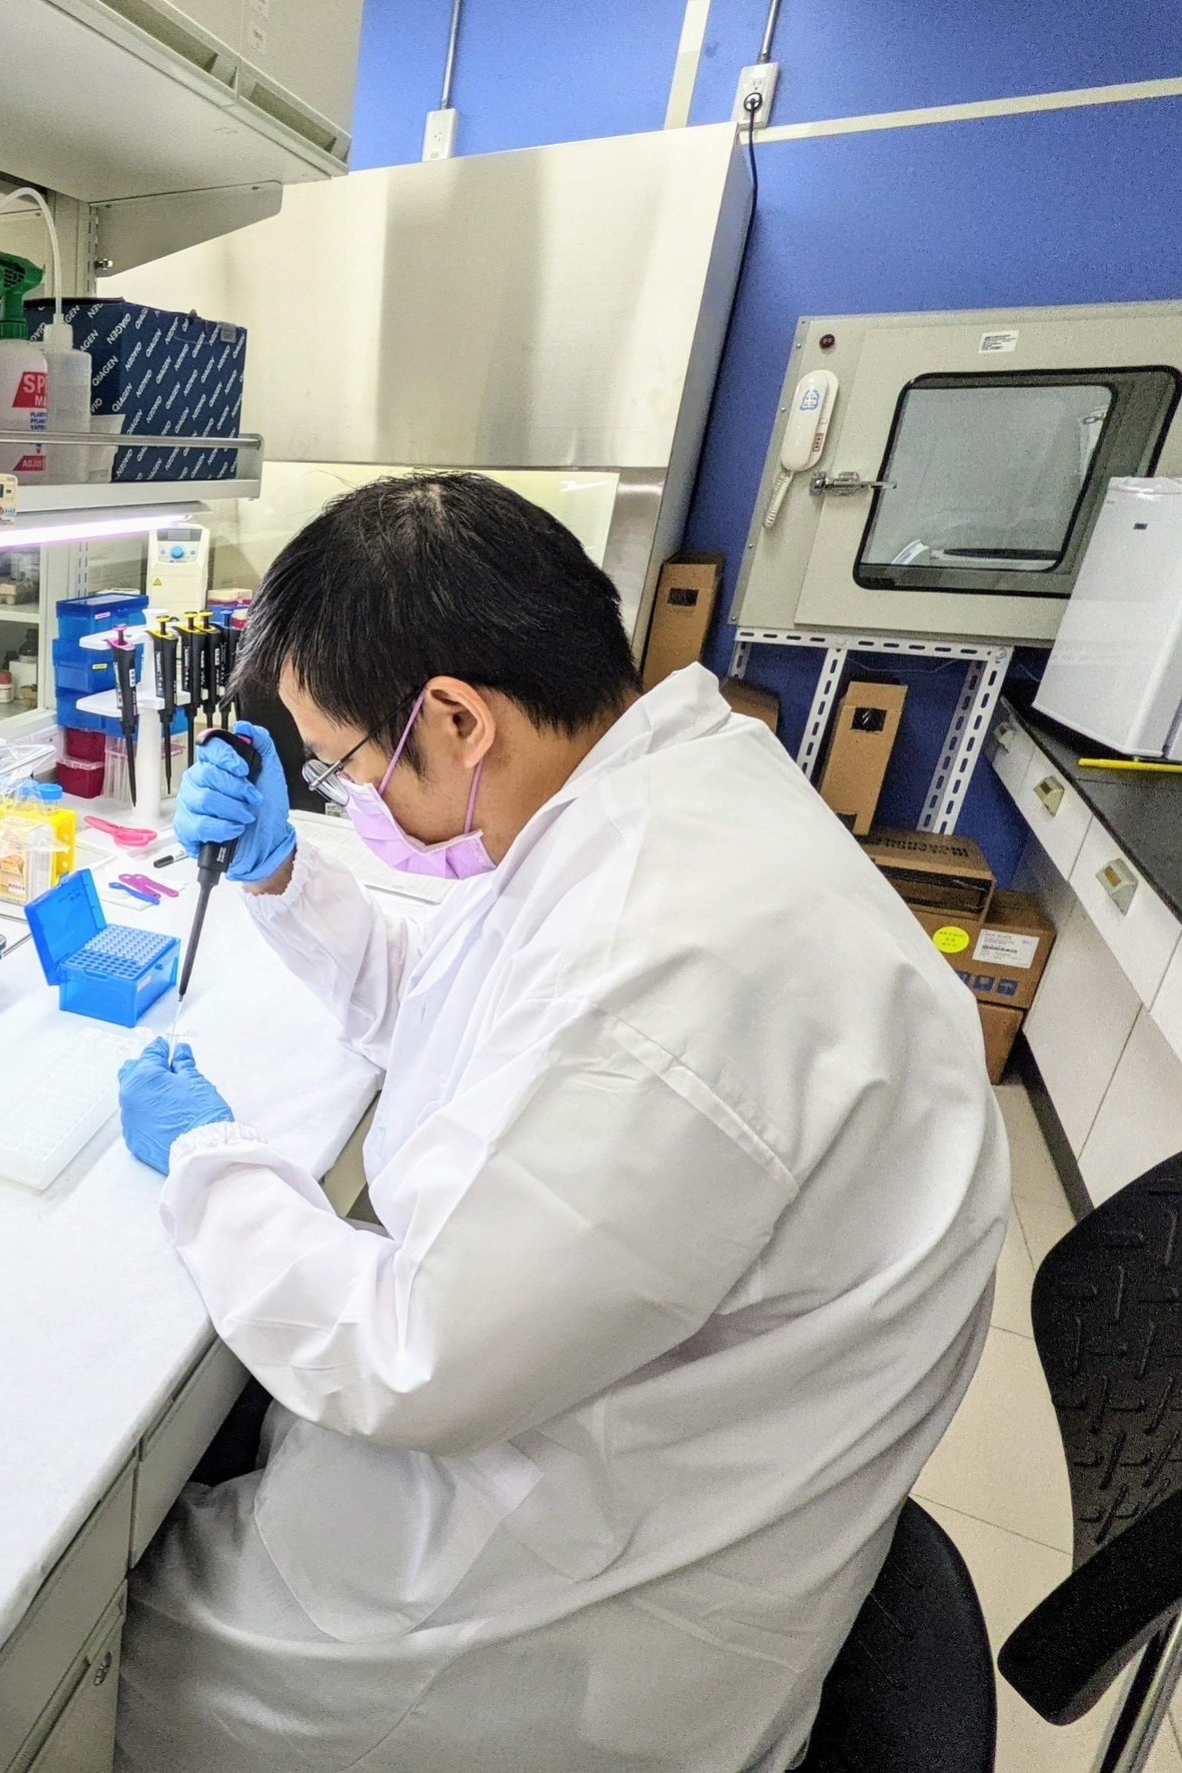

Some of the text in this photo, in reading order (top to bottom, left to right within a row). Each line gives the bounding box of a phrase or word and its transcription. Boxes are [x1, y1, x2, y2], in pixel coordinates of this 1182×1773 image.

[106, 313, 131, 345] QIAGEN
[146, 328, 162, 358] QIAGEN
[125, 342, 142, 371] QIAGEN
[174, 343, 189, 371] QIAGEN
[192, 331, 206, 358] QIAGEN
[217, 345, 230, 371] QIAGEN
[92, 355, 119, 387] QIAGEN
[136, 369, 152, 398] QIAGEN
[156, 355, 171, 384] QIAGEN
[184, 369, 198, 397] QIAGEN
[201, 356, 214, 384] QIAGEN
[224, 370, 237, 395] QIAGEN
[111, 382, 132, 412] QIAGEN
[165, 382, 180, 410] QIAGEN
[192, 394, 206, 420] QIAGEN
[209, 381, 222, 408] QIAGEN
[146, 395, 162, 424] QIAGEN
[174, 406, 189, 434] QIAGEN
[217, 405, 229, 430] QIAGEN
[116, 448, 133, 477] QIAGEN
